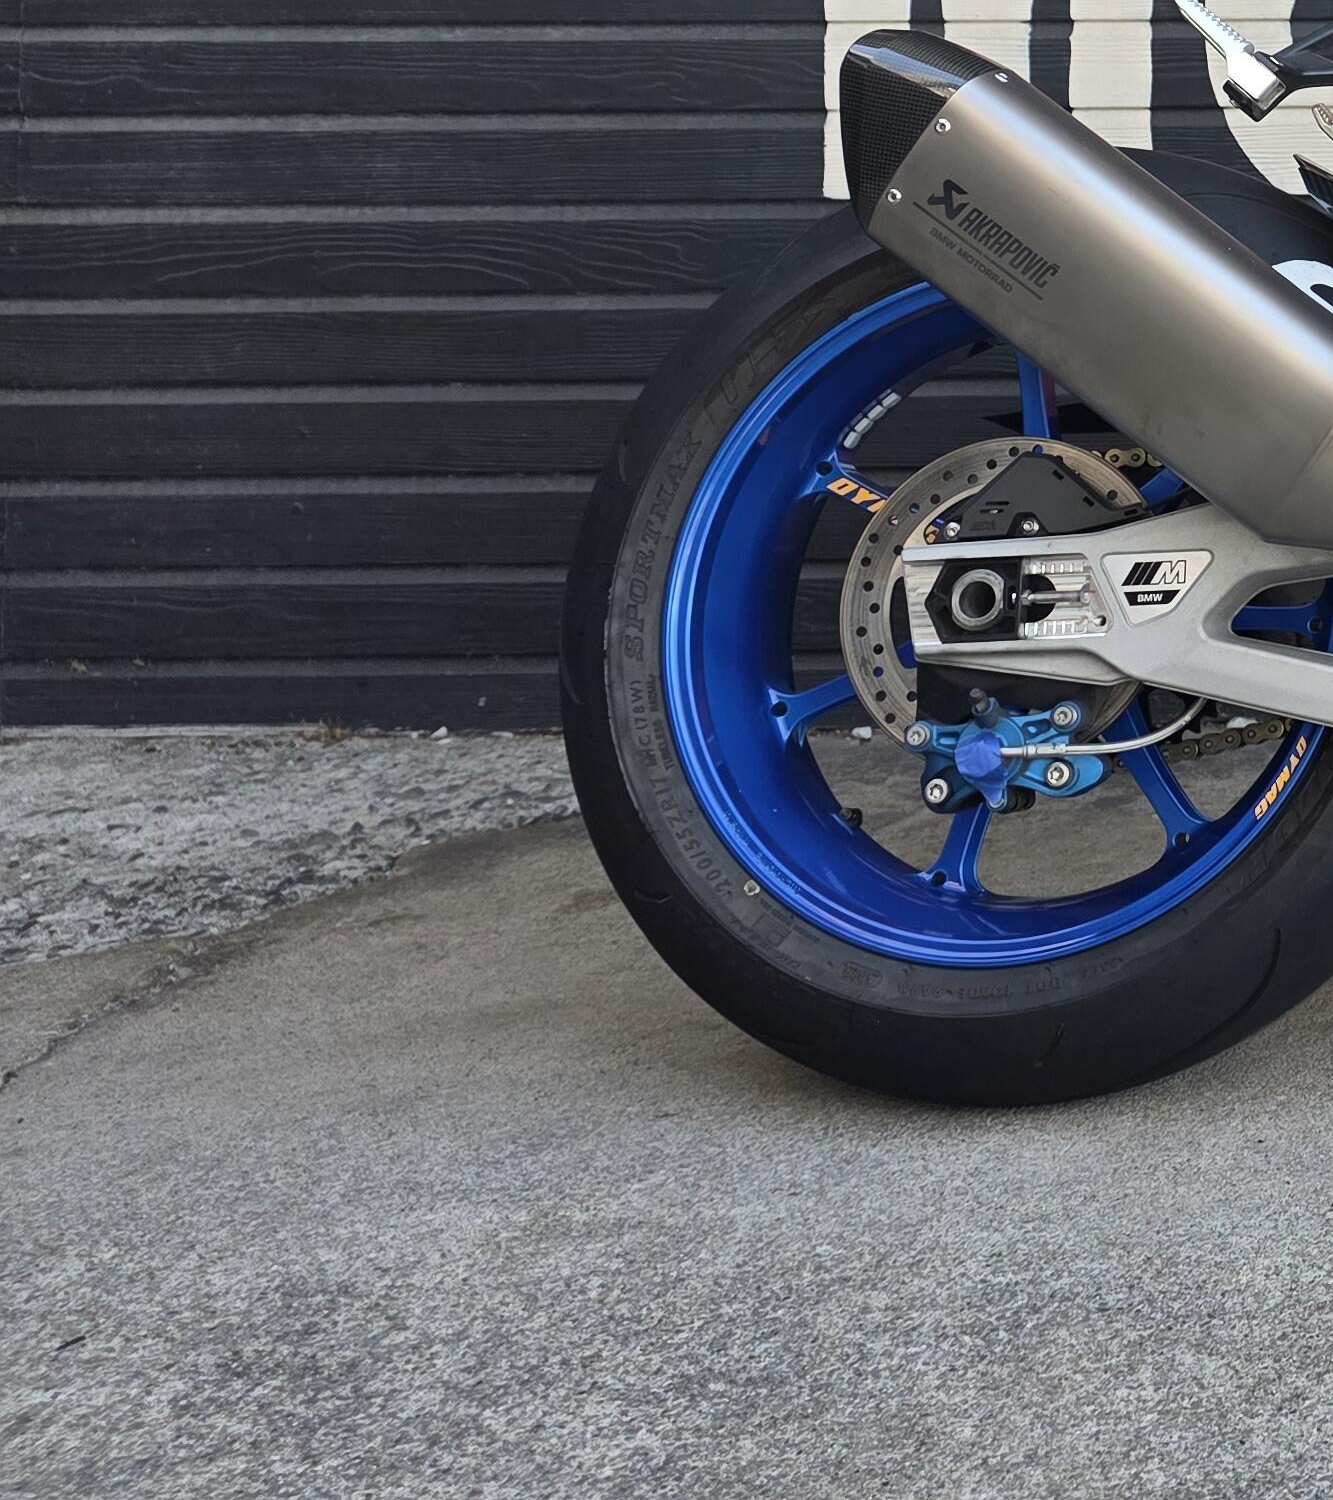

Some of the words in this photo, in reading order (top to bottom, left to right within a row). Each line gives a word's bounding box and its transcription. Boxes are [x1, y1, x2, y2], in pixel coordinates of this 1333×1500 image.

[929, 227, 958, 250] BMW
[956, 247, 1013, 293] MOTORRAD
[624, 431, 702, 662] SPORTMAX
[1136, 592, 1164, 603] BMW
[1254, 735, 1307, 821] DYMAG
